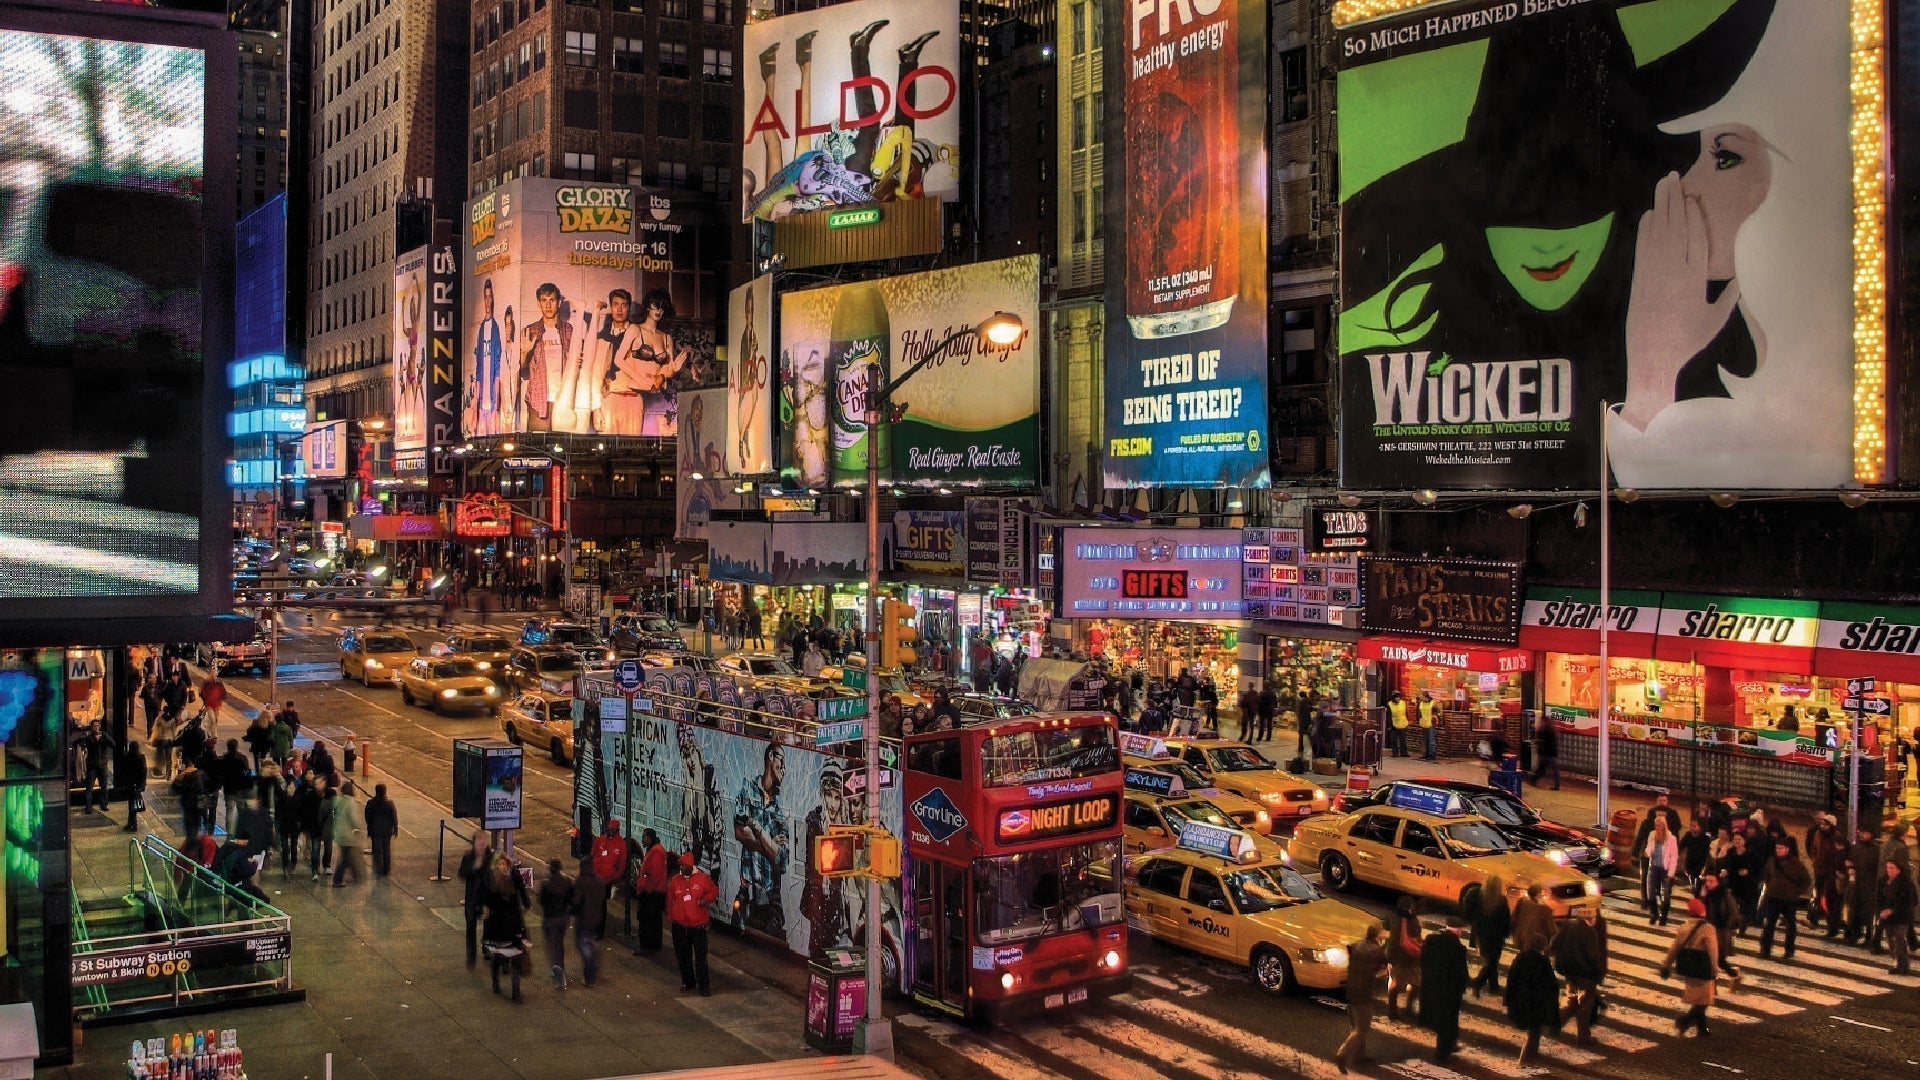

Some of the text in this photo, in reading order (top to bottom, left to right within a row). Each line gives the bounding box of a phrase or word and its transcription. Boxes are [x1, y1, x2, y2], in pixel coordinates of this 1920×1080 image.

[1132, 42, 1176, 80] healthy
[745, 65, 956, 144] ALDO
[556, 186, 632, 208] GLORY
[649, 195, 670, 209] tbs
[472, 192, 496, 223] GLORY
[560, 207, 633, 234] DAZE
[640, 221, 658, 232] very
[834, 212, 878, 226] LAMAR
[472, 214, 496, 247] DAZE
[575, 238, 667, 255] november 16
[567, 252, 673, 271] tuesdays 10pm
[1149, 279, 1161, 291] 11.5
[1162, 276, 1170, 289] FL
[1172, 273, 1181, 287] OZ
[1154, 283, 1210, 303] DIETARY SUPPLEMENT
[902, 324, 975, 369] Holly Jolly
[729, 355, 767, 394] ALDO
[1141, 350, 1221, 387] TIRED OF
[1124, 387, 1242, 425] BEING TIRED?
[1202, 433, 1209, 443] BY
[1398, 440, 1565, 452] GERSHWIN THEATRE, 222 WEST 51st STREET
[1111, 438, 1152, 457] FRS.COM
[508, 457, 550, 468] Van Wagner
[909, 444, 1022, 472] Real Ginger. Real Taste.
[1425, 453, 1511, 465] WickedtheMusical.com
[975, 520, 998, 531] VIDEOS
[1323, 512, 1367, 533] TADS
[907, 526, 955, 550] GIFTS
[1272, 531, 1297, 543] T-SHIRTS
[1245, 548, 1269, 559] T-SHIRTS
[1126, 572, 1185, 596] GIFTS
[1248, 567, 1356, 586] CAPS T-SHIRTS T-SHIRTS
[1245, 586, 1326, 601] T-SHIRTS CAPS T-SHIRTS
[1271, 604, 1297, 618] T-SHIRTS
[1303, 607, 1321, 619] CAPS
[1418, 594, 1508, 629] STEAKS
[1539, 596, 1639, 630] sbarro
[1679, 603, 1794, 643] sbarro
[1382, 646, 1408, 660] TAD'S
[1426, 650, 1467, 668] STEAKS
[1499, 654, 1527, 671] TAD'S
[72, 662, 88, 677] M
[1563, 663, 1588, 674] Pizza
[1607, 666, 1647, 681] esserts
[850, 671, 855, 686] 7
[1735, 680, 1764, 693] Pasta
[829, 702, 838, 717] W
[840, 700, 853, 716] 47
[1868, 701, 1884, 709] WAY
[1551, 711, 1575, 723] sbarro
[1649, 718, 1687, 730] EATERY
[817, 723, 863, 738] FATHER DUFFY
[1795, 744, 1827, 757] sbarro
[614, 762, 668, 793] PRSENTS
[1048, 767, 1072, 778] 71336
[1126, 772, 1169, 788] SKYLINE
[1031, 799, 1110, 831] NIGHT LOOP
[81, 950, 192, 971] St Subway Station
[112, 969, 119, 978] &
[120, 966, 145, 978] Bklyn
